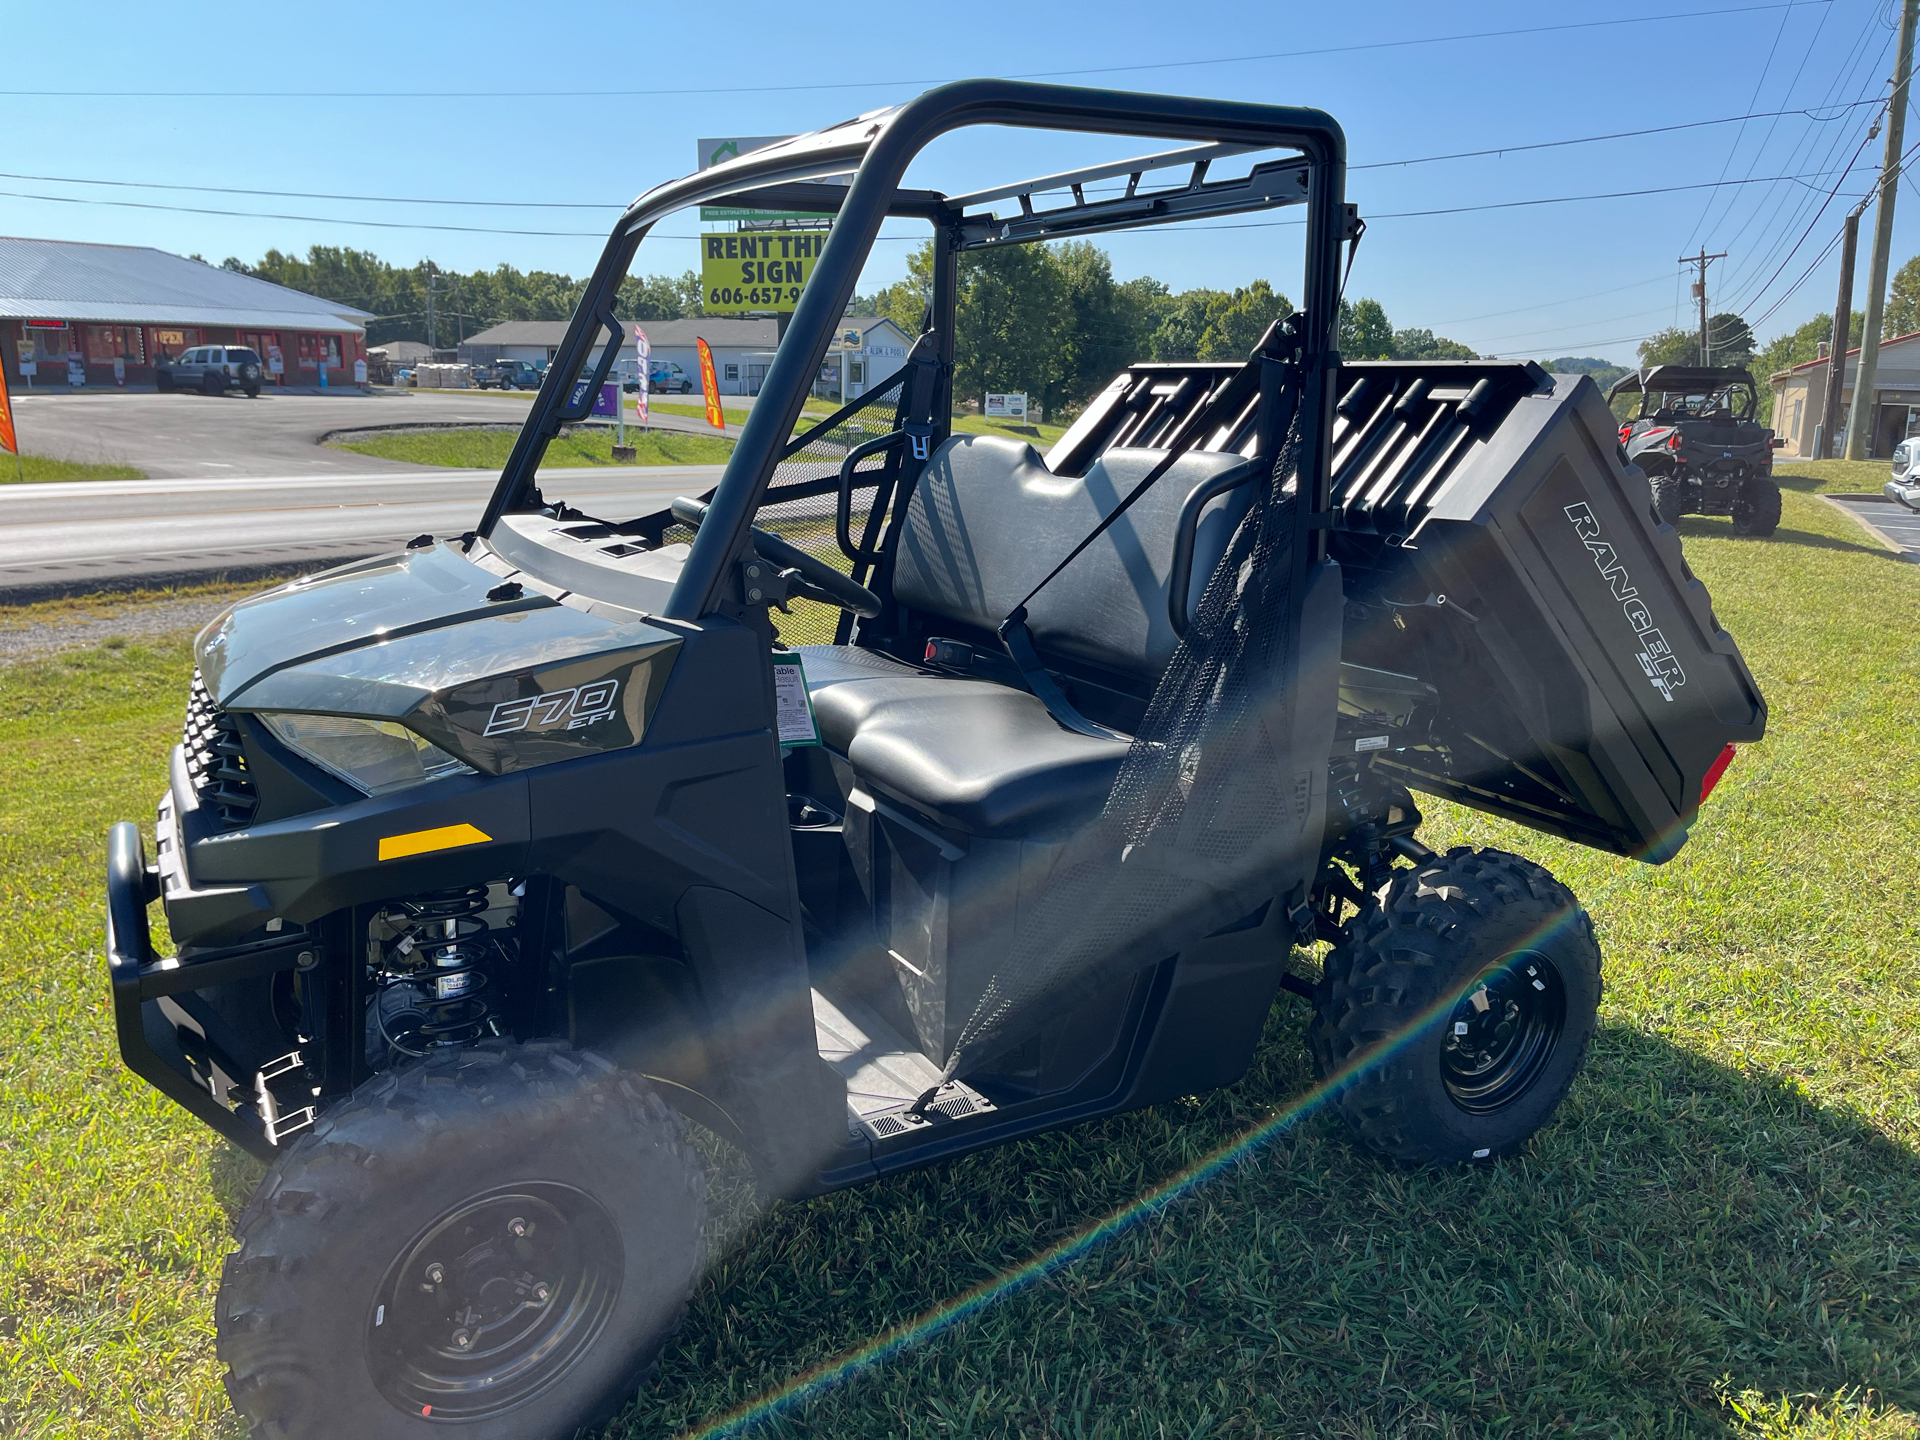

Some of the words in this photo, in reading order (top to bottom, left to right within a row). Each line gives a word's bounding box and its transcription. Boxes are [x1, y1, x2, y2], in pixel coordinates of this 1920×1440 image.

[707, 234, 773, 259] RENT
[778, 234, 829, 258] THI
[741, 260, 803, 284] SIGN
[710, 287, 805, 305] 606-657-9
[154, 331, 184, 346] OPEN
[890, 348, 906, 357] POOLS
[1563, 501, 1686, 690] RANGER
[483, 679, 618, 737] 570
[566, 710, 616, 731] EFI
